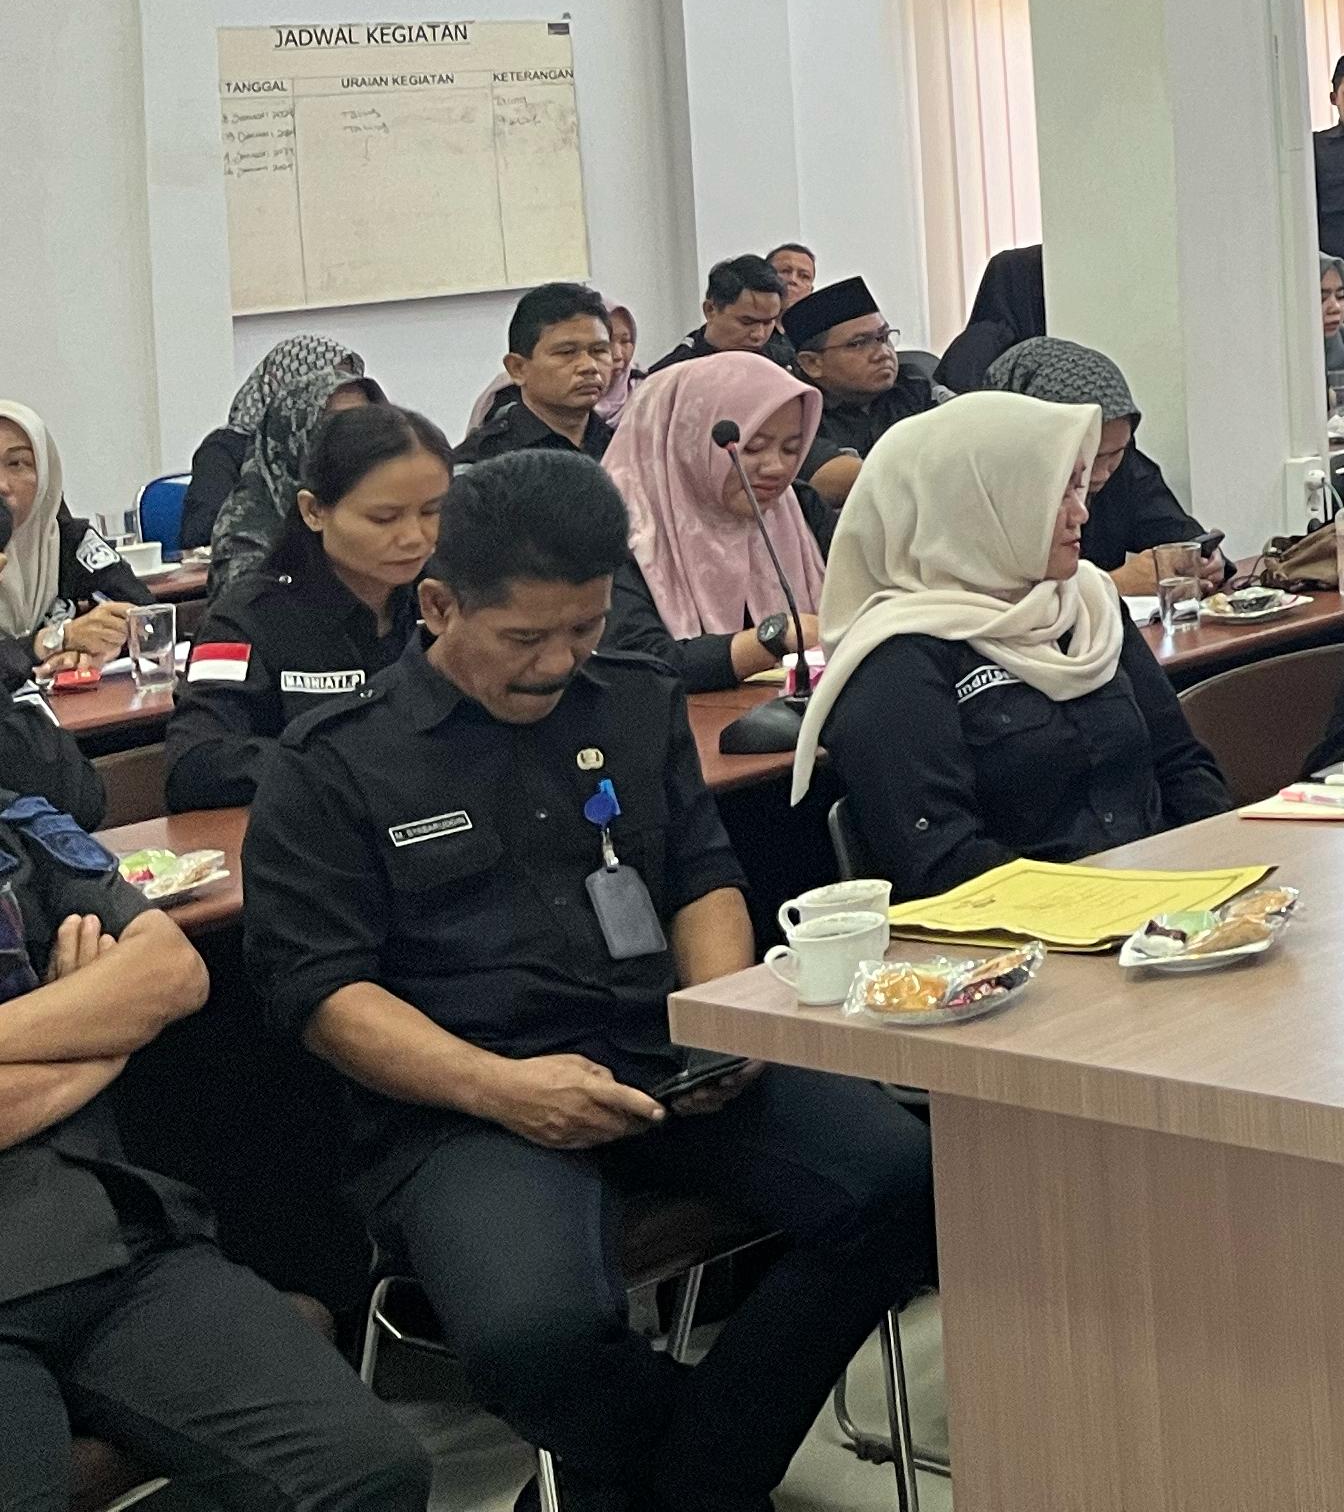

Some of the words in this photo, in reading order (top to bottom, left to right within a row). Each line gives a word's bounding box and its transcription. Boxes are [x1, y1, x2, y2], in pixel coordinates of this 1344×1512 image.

[275, 26, 360, 48] JADWAL
[366, 24, 468, 45] KEGIATAN
[341, 76, 389, 89] URAIAN
[392, 74, 455, 87] KEGIATAN
[493, 69, 574, 83] KETERANGAN
[225, 80, 287, 94] TANGGAL
